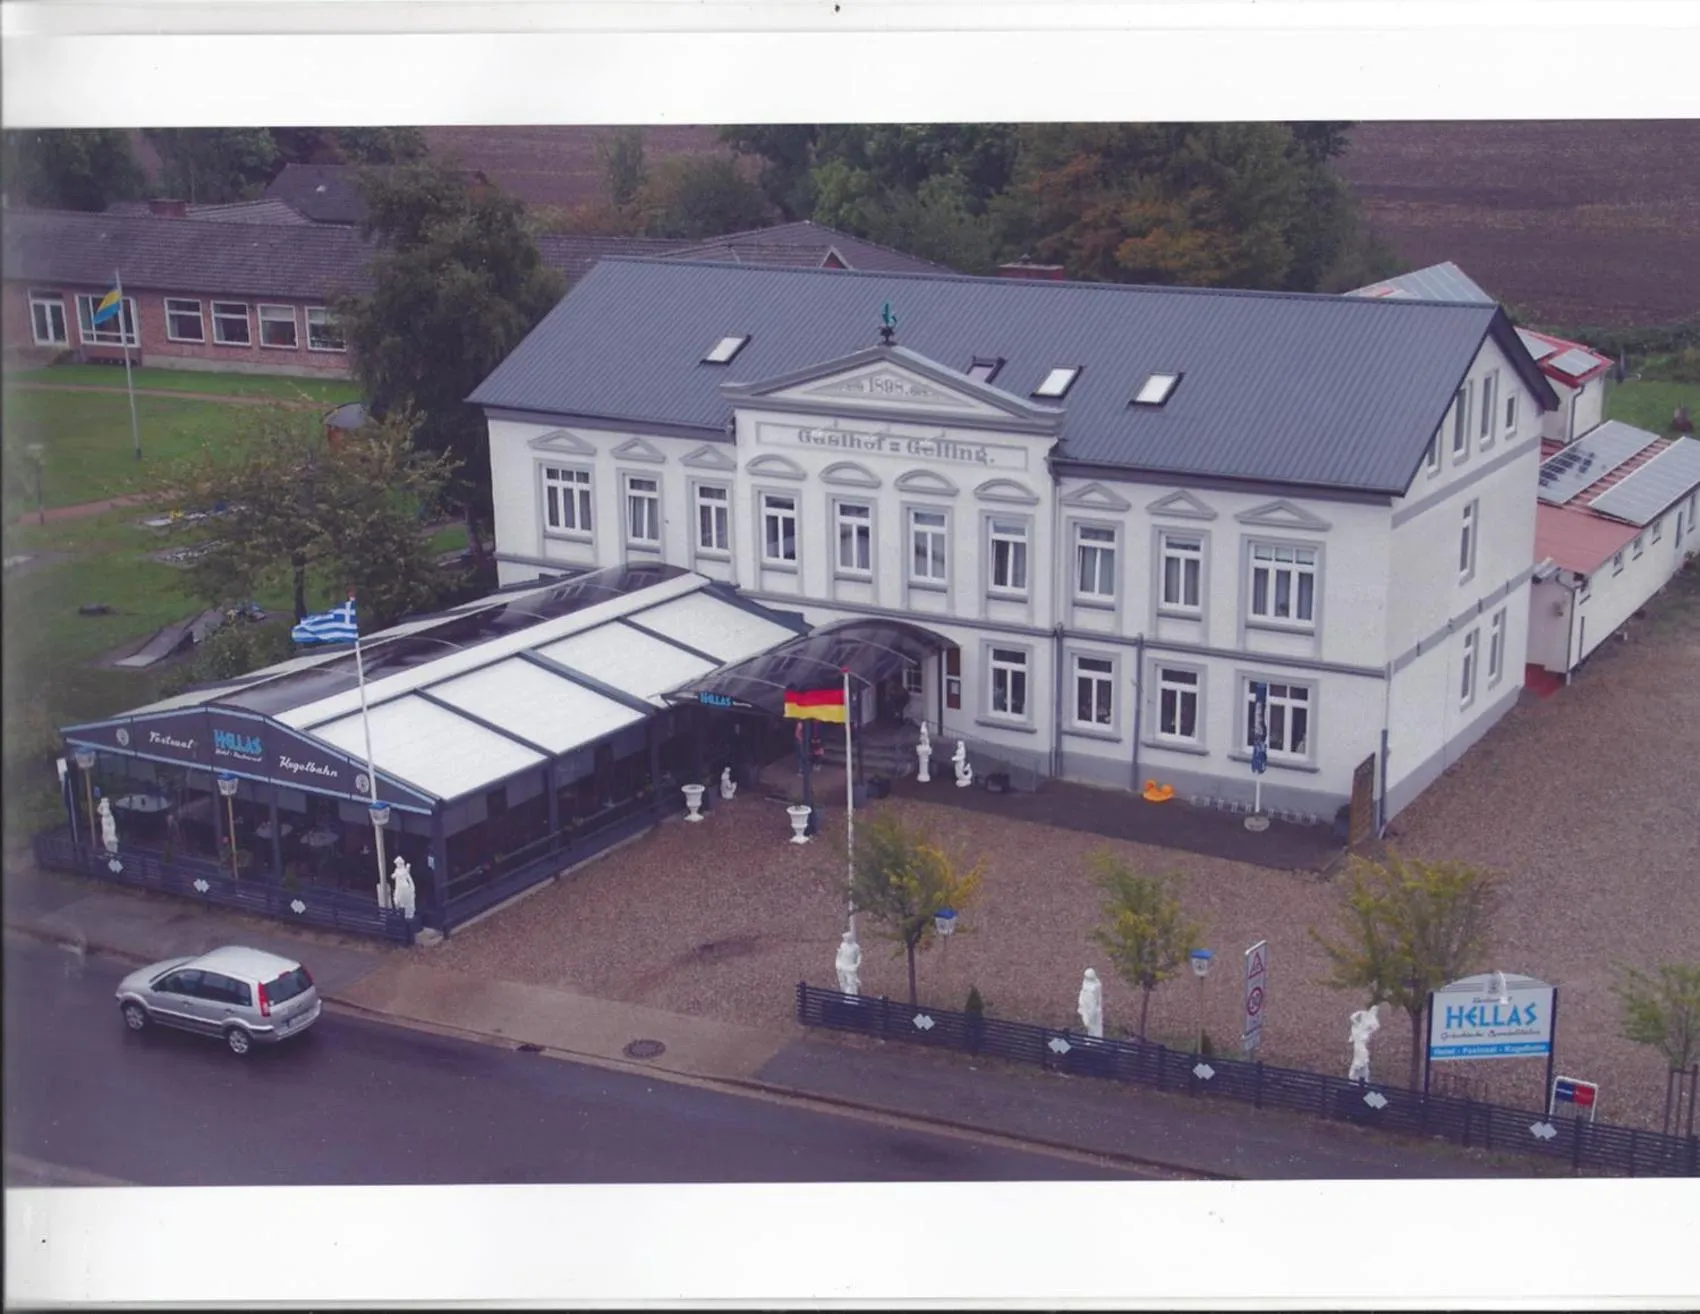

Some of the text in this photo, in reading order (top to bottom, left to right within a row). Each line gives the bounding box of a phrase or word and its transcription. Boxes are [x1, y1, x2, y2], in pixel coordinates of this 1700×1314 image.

[213, 728, 263, 755] HELLAS
[279, 755, 338, 778] Kegelbahn
[1445, 1002, 1538, 1029] HELLAS
